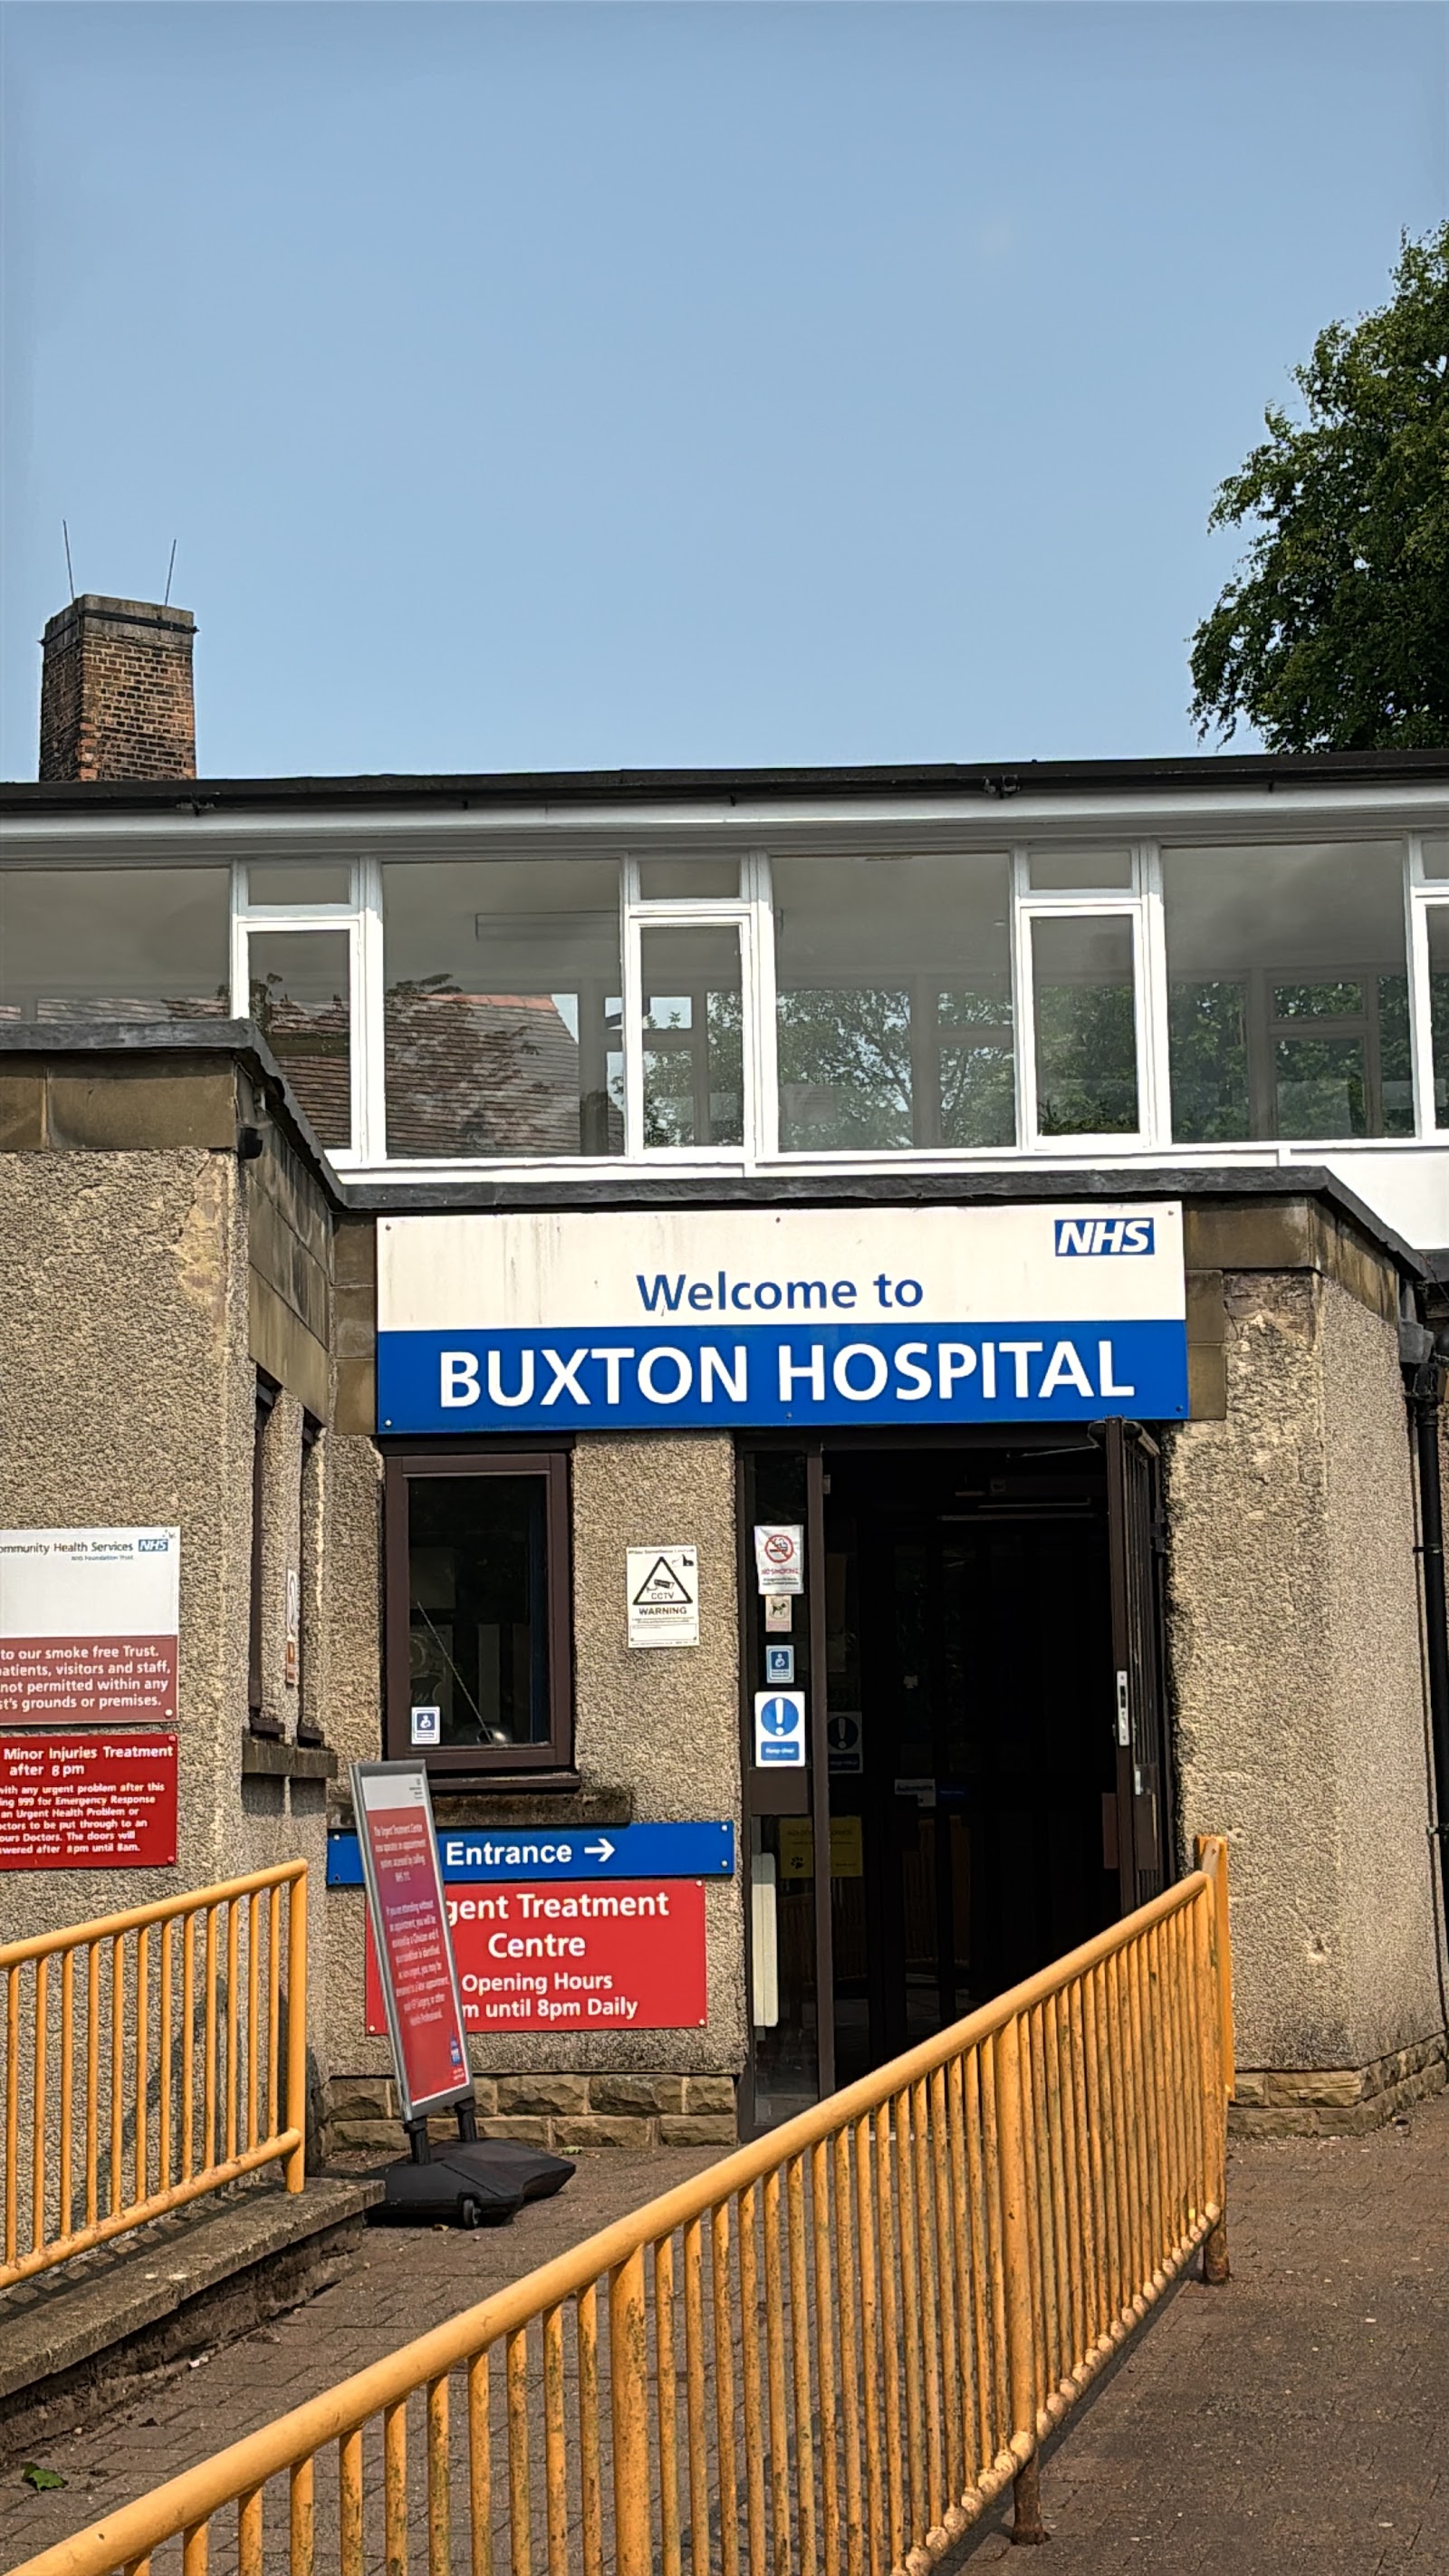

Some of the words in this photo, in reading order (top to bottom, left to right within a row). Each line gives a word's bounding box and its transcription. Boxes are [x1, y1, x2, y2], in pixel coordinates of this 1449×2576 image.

[1055, 1219, 1154, 1255] NHS
[636, 1271, 857, 1311] Welcome
[874, 1273, 924, 1308] to
[439, 1345, 749, 1409] BUXTON
[779, 1341, 1136, 1402] HOSPITAL
[53, 1542, 88, 1552] Health
[91, 1541, 133, 1552] Services
[139, 1539, 168, 1552] NHS
[639, 1607, 687, 1616] WARNING
[1, 1649, 14, 1660] to
[18, 1649, 42, 1659] our
[45, 1646, 89, 1658] smoke
[92, 1645, 120, 1658] free
[122, 1645, 159, 1657] Trust.
[56, 1662, 104, 1675] visitors
[108, 1661, 133, 1674] and
[137, 1660, 171, 1675] staff,
[0, 1683, 24, 1694] not
[27, 1679, 93, 1696] permitted
[97, 1678, 140, 1692] within
[144, 1679, 168, 1692] any
[22, 1696, 77, 1713] grounds
[81, 1697, 95, 1708] or
[99, 1694, 162, 1710] premises.
[4, 1748, 44, 1761] Minor
[49, 1746, 98, 1763] Injuries
[103, 1745, 174, 1759] Treatment
[9, 1763, 43, 1777] after
[21, 1786, 39, 1797] any
[42, 1784, 74, 1797] urgent
[77, 1783, 117, 1796] problem
[120, 1782, 144, 1792] after
[147, 1782, 165, 1792] this
[37, 1796, 52, 1806] for
[54, 1796, 107, 1807] Emergency
[110, 1793, 156, 1806] Response
[15, 1809, 49, 1821] Urgent
[52, 1807, 83, 1818] Health
[86, 1806, 125, 1817] Problem
[0, 1821, 26, 1831] ctors
[29, 1821, 41, 1830] to
[43, 1820, 56, 1830] be
[59, 1821, 76, 1831] put
[79, 1818, 118, 1831] through
[120, 1818, 132, 1828] to
[135, 1820, 148, 1828] an
[23, 1832, 63, 1842] Doctors.
[66, 1831, 84, 1841] The
[87, 1831, 115, 1841] doors
[118, 1830, 136, 1840] will
[36, 1843, 61, 1854] after
[91, 1842, 114, 1852] until
[446, 1841, 572, 1866] Entrance
[446, 1896, 509, 1927] gent
[516, 1892, 670, 1919] Treatment
[488, 1932, 586, 1959] Centre
[462, 1974, 547, 1995] Opening
[553, 1973, 613, 1992] Hours
[486, 1998, 531, 2018] until
[537, 1999, 581, 2021] 8pm
[587, 1996, 638, 2020] Daily
